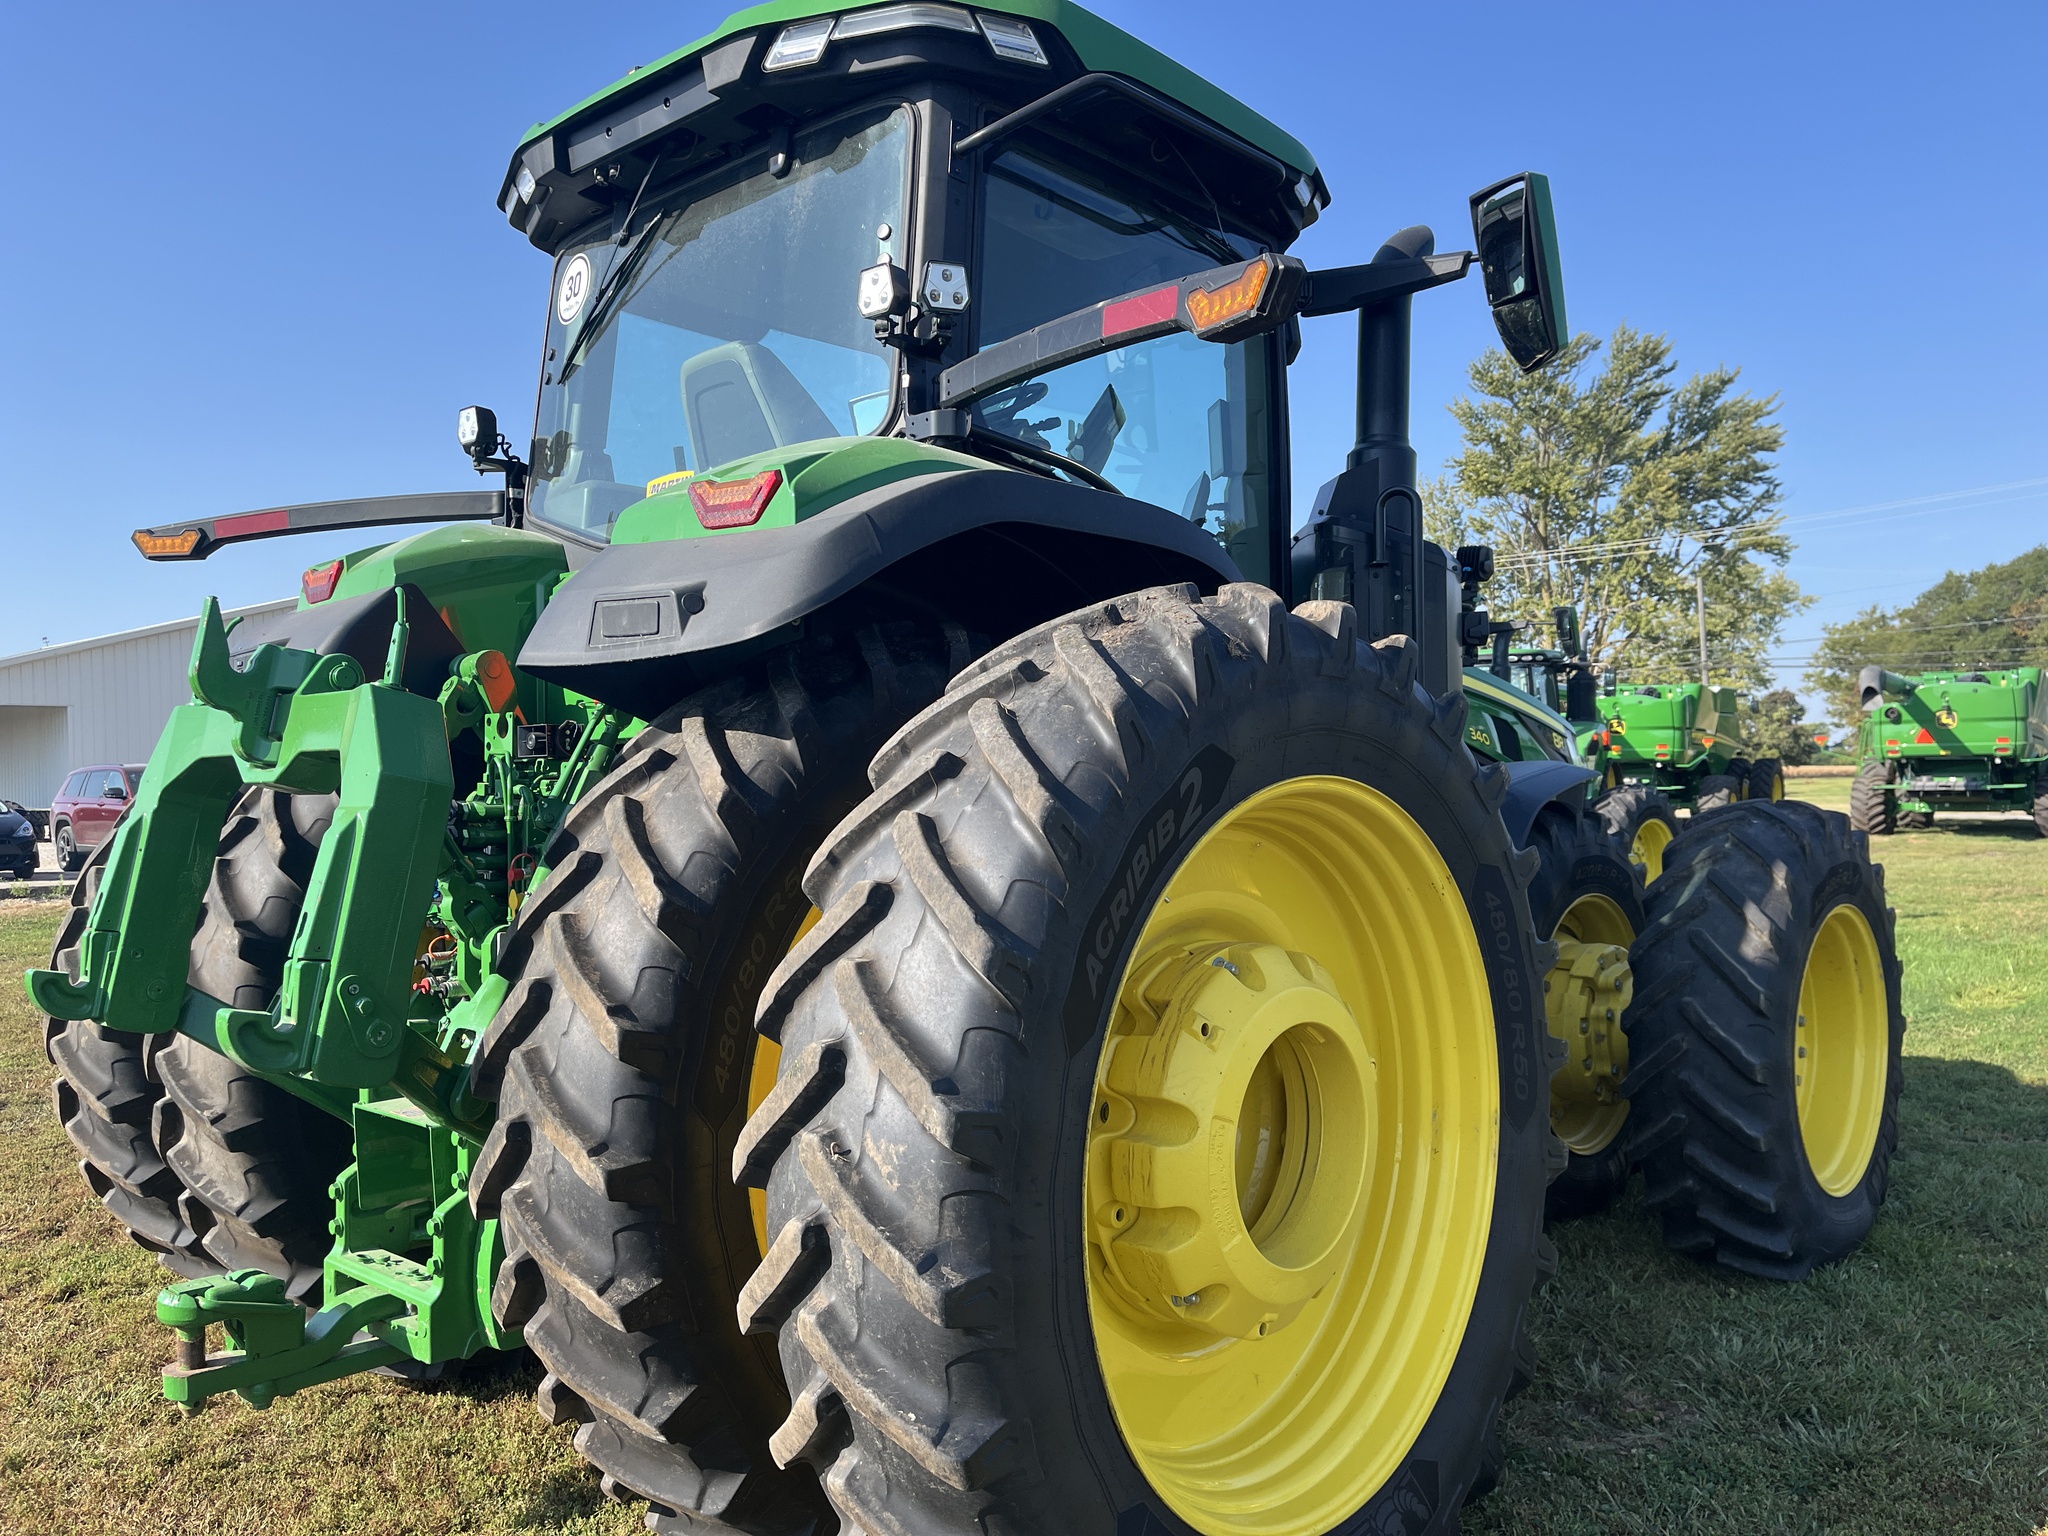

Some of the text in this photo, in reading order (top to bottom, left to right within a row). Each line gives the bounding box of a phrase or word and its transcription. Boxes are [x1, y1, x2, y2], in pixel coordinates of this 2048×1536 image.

[565, 270, 582, 302] 30
[1468, 727, 1491, 746] 340
[1552, 731, 1567, 750] 8R
[1085, 765, 1204, 1001] AGRIBIB 2
[714, 931, 768, 1095] 480/80
[1484, 889, 1530, 1102] 480/80 R50
